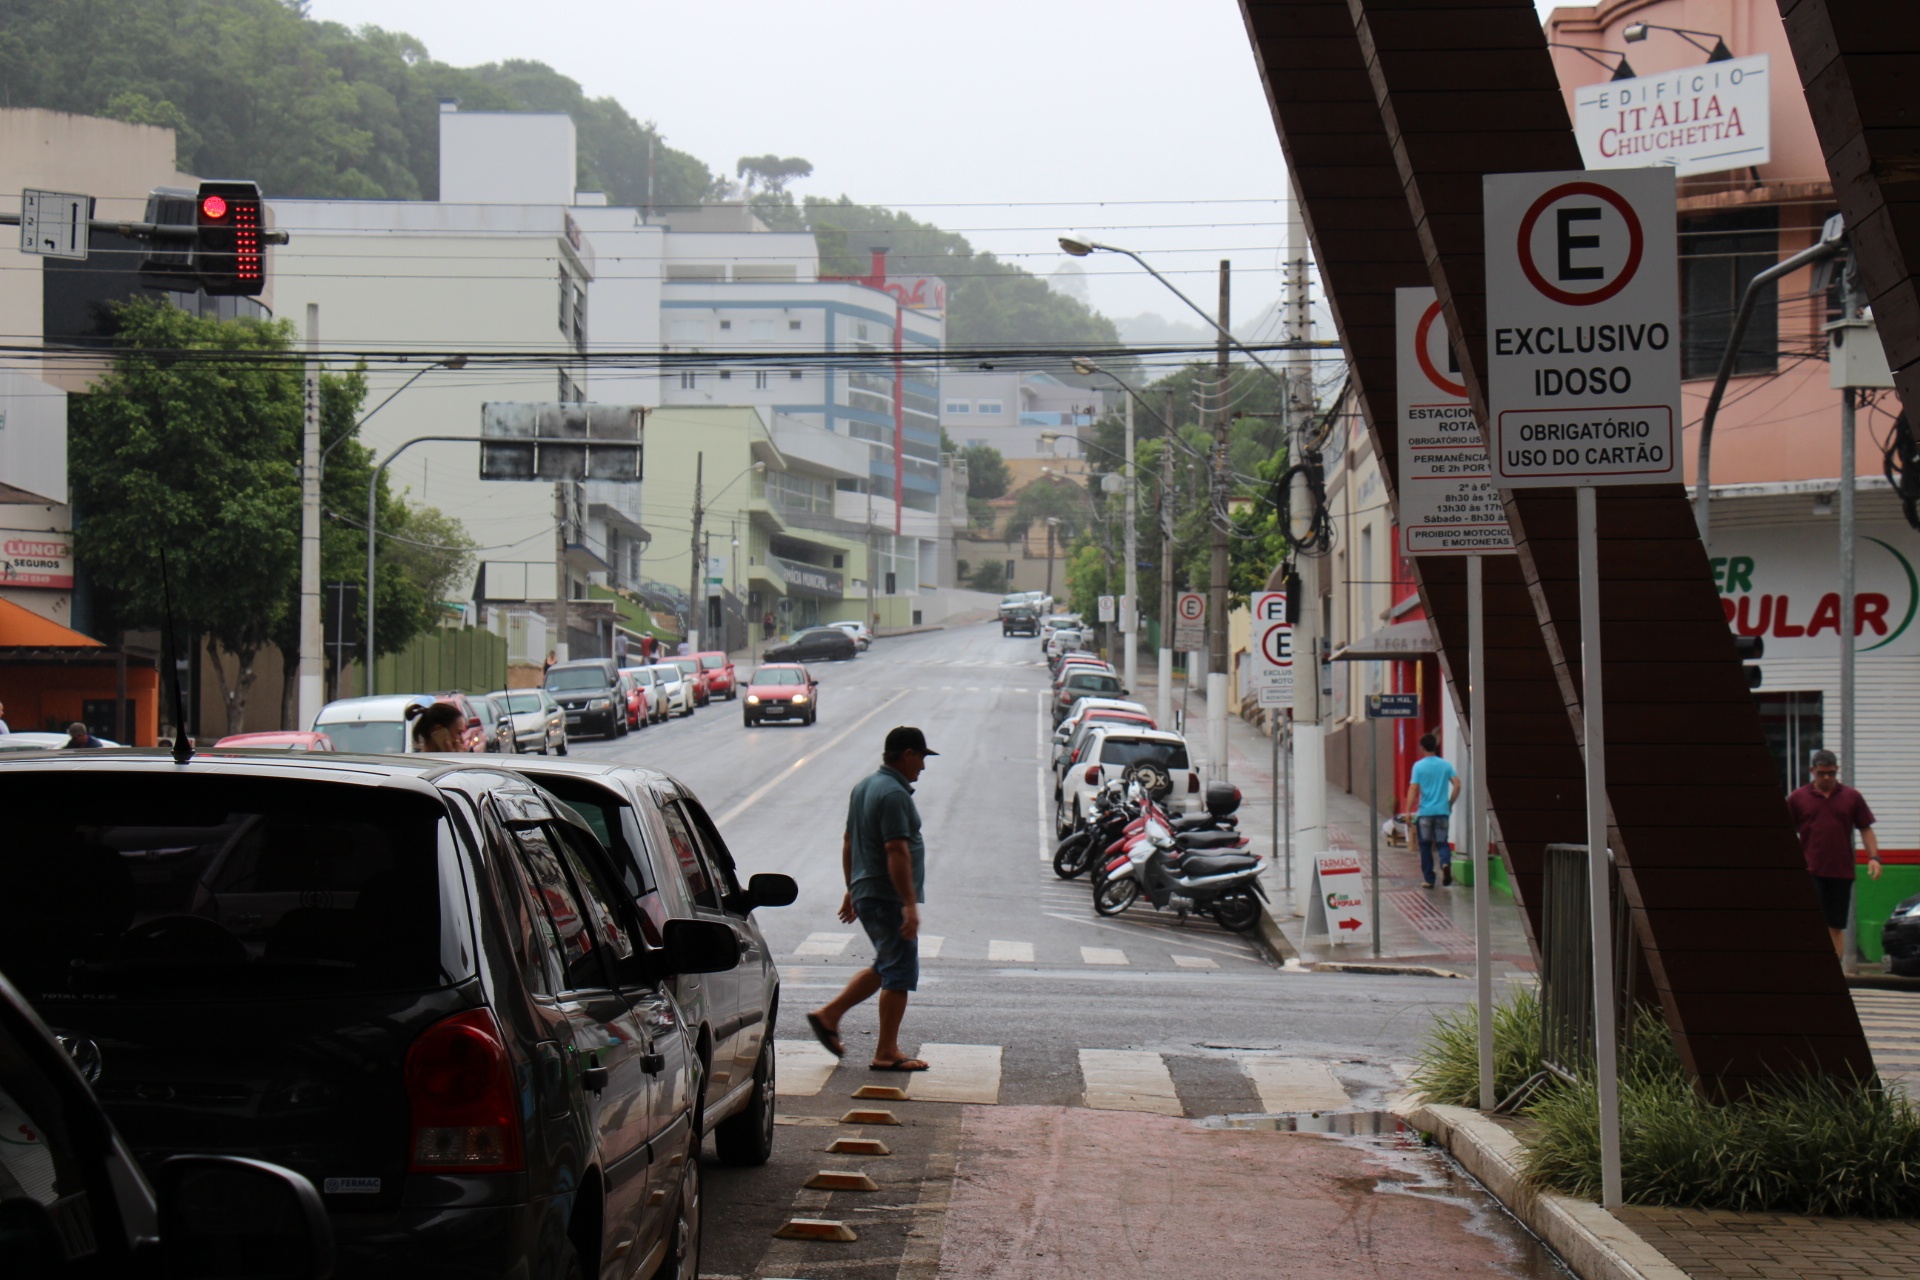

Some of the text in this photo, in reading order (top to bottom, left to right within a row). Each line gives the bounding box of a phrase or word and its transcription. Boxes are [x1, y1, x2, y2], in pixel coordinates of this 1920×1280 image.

[1599, 68, 1743, 108] EDIFÍCIO
[1618, 94, 1723, 134] ITALIA
[1599, 106, 1745, 158] CHIUCHETTA
[29, 197, 34, 205] 1
[27, 238, 33, 246] 3
[1557, 207, 1604, 281] E
[1495, 323, 1669, 355] EXCLUSIVO
[1535, 366, 1631, 396] IDOSO
[1520, 418, 1649, 442] OBRIGATÓRIO
[1408, 436, 1467, 445] OBRIGATÓRIO
[1414, 453, 1488, 463] PERMANÊNCIA
[1508, 442, 1663, 467] USO DO CARTÃO
[1431, 463, 1485, 473] DE 2h POR
[1445, 494, 1469, 502] 8h30
[1472, 493, 1484, 501] às
[1424, 515, 1462, 523] Sábado
[1471, 514, 1495, 522] 8h30
[1415, 530, 1461, 538] PROIBIDO
[1451, 538, 1509, 546] MOTONETAS
[8, 542, 66, 556] LUNGE
[14, 559, 60, 569] SEGUROS
[1187, 601, 1196, 615] E
[1277, 633, 1292, 657] E
[341, 1179, 379, 1187] FERMAC
